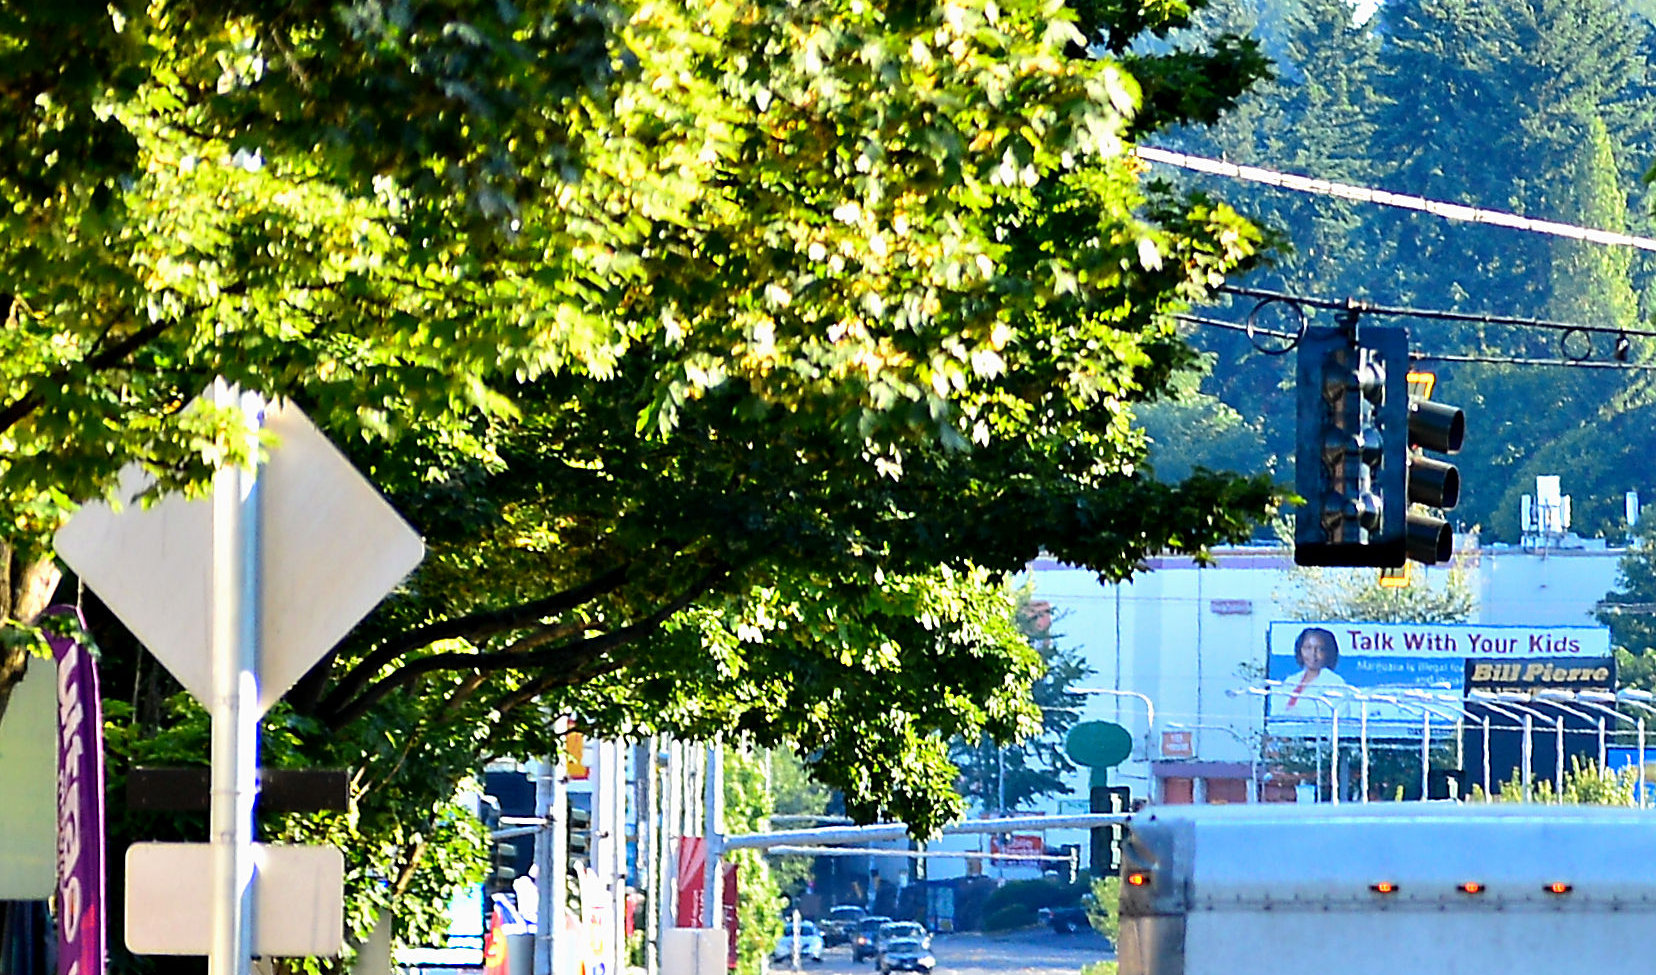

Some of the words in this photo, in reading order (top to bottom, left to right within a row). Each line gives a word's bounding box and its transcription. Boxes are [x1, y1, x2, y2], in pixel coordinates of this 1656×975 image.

[1347, 630, 1394, 651] Talk
[1403, 631, 1457, 652] With
[1467, 633, 1518, 654] Your
[1529, 633, 1580, 653] Kids
[1471, 662, 1521, 682] Bill
[1522, 662, 1609, 682] Pierre
